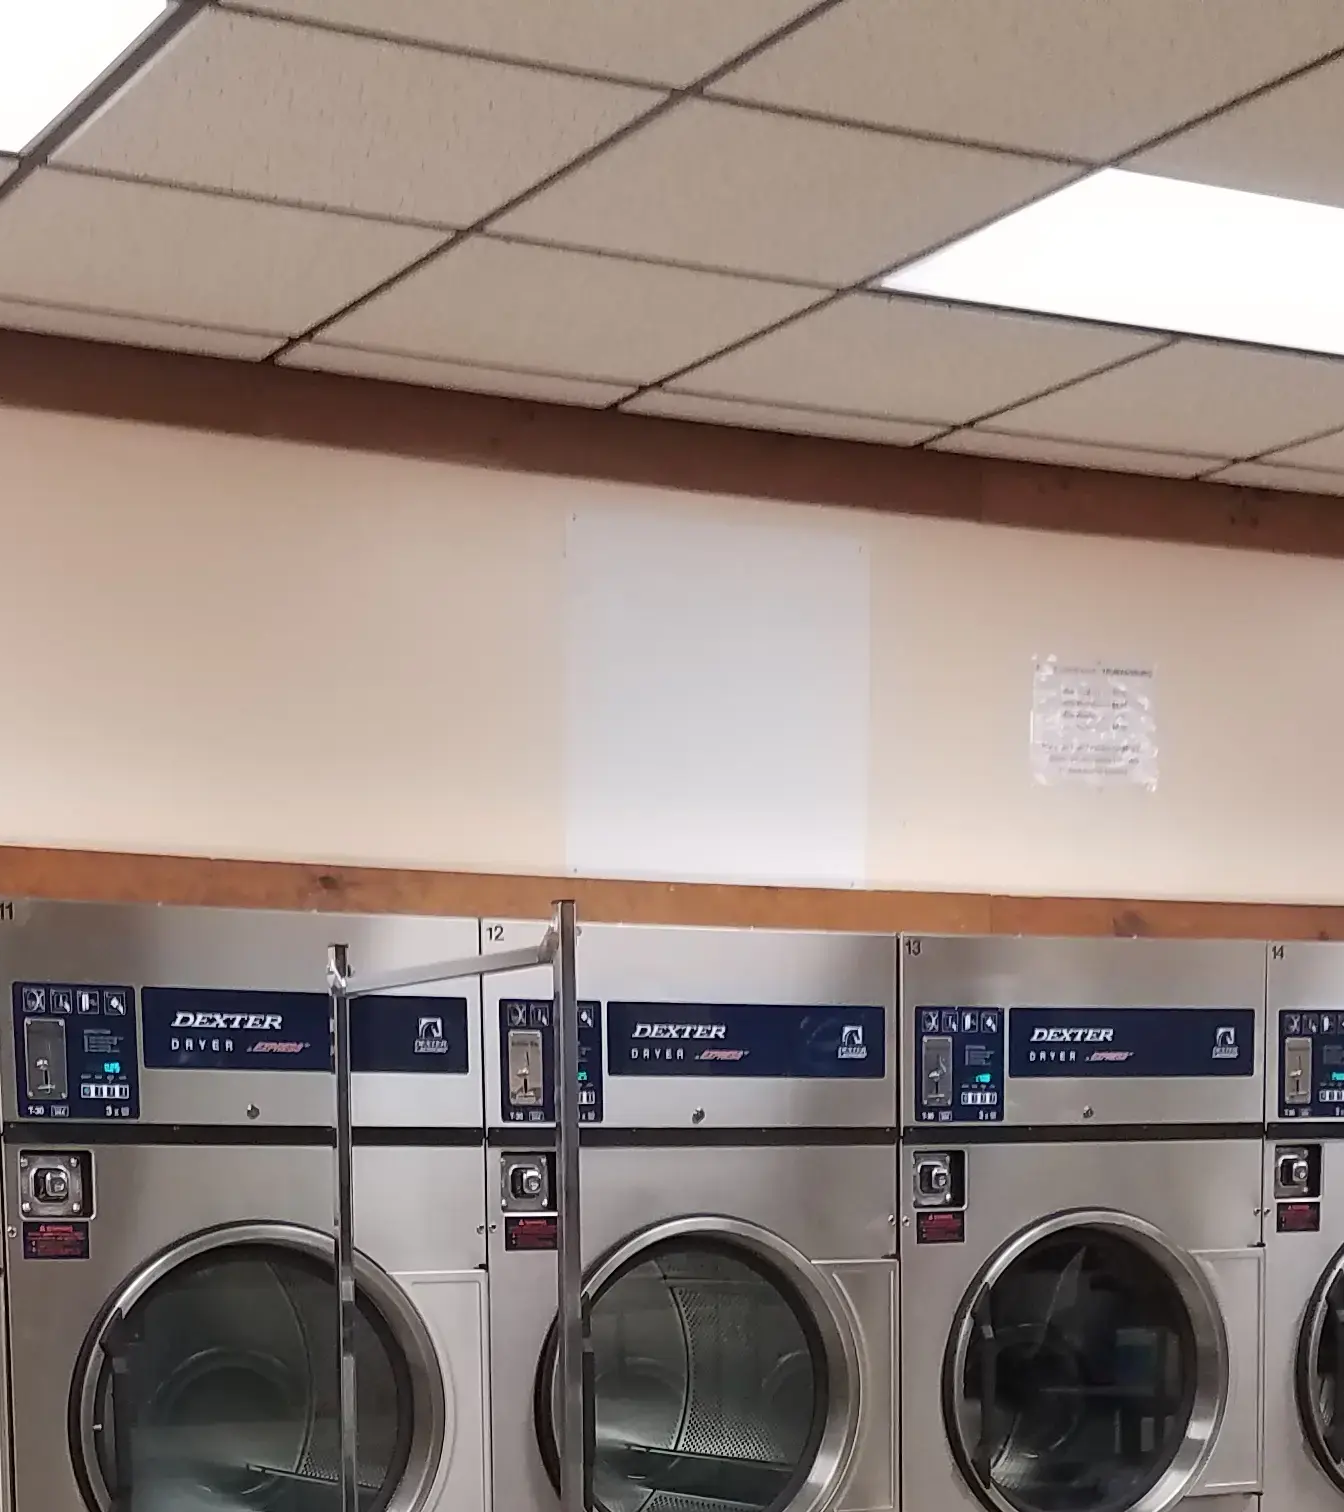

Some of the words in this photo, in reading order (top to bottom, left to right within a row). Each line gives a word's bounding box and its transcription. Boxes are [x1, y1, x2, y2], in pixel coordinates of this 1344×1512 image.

[487, 926, 504, 941] 12
[906, 940, 921, 956] 13
[1272, 946, 1284, 960] 14
[171, 1011, 283, 1030] DEXTER
[632, 1023, 727, 1039] DEXTER
[1030, 1028, 1114, 1042] DEXTER
